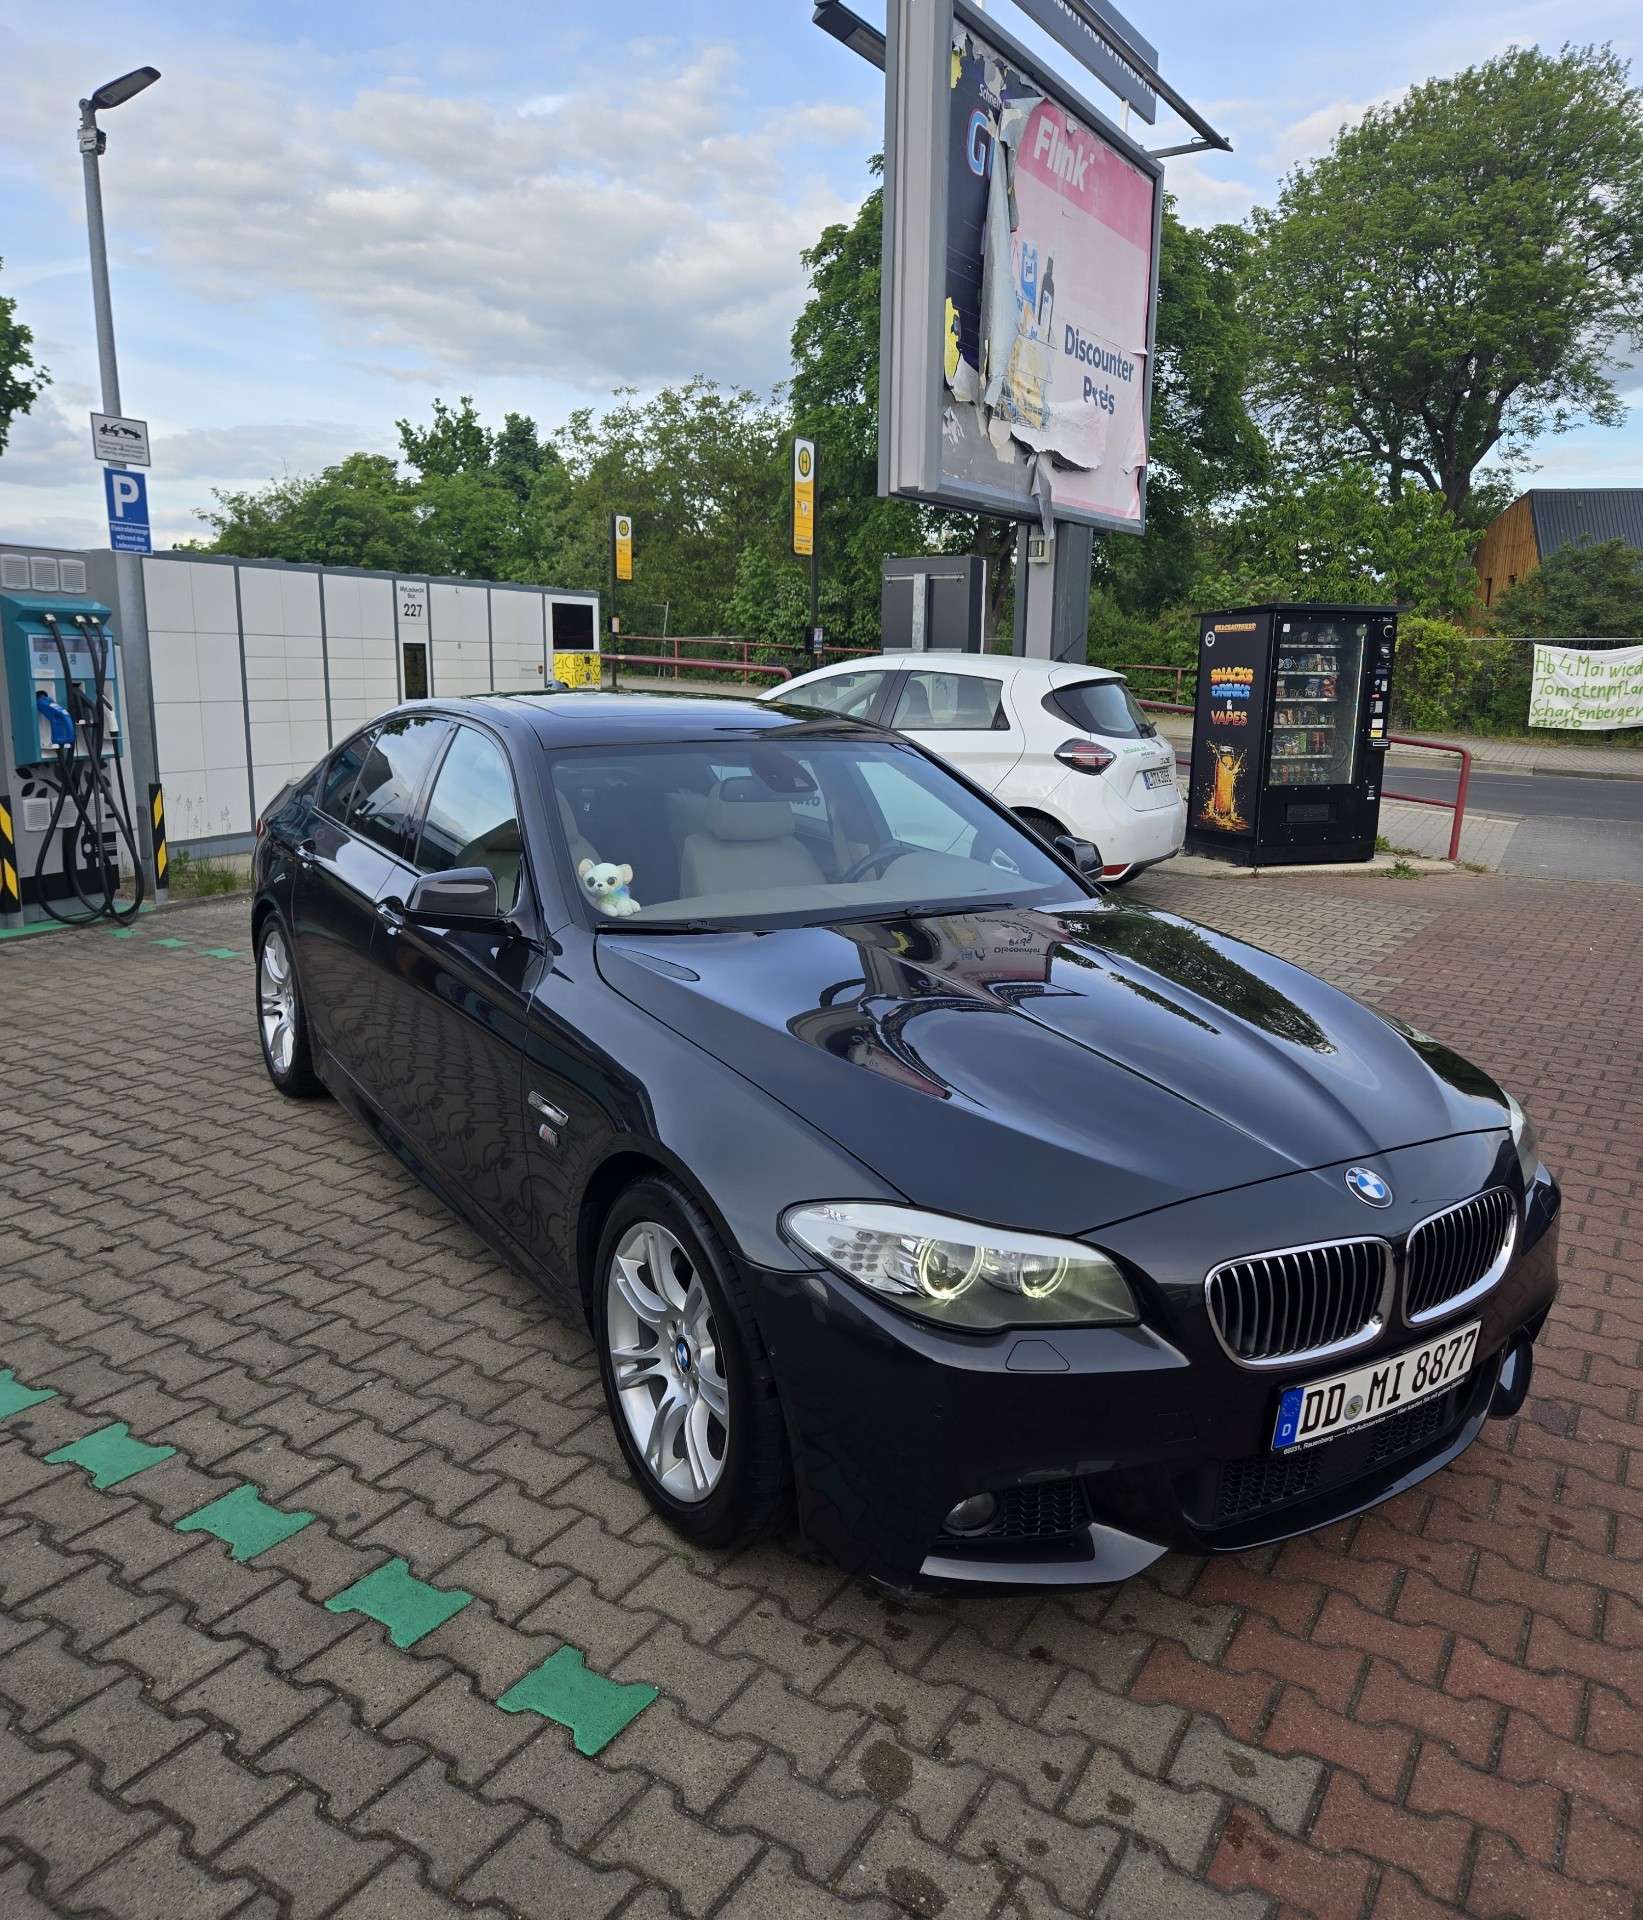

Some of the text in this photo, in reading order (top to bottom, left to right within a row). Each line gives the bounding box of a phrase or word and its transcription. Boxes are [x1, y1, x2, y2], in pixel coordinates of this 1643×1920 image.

[1033, 115, 1090, 192] Flink
[1064, 323, 1134, 382] Discounter
[403, 603, 422, 617] 227
[1535, 649, 1556, 674] Ab
[1211, 667, 1254, 683] SNACKS
[1211, 683, 1251, 698] DRINKS
[1210, 711, 1248, 726] VAPES
[1300, 1328, 1477, 1434] DD MI 8877
[1282, 1423, 1291, 1437] D
